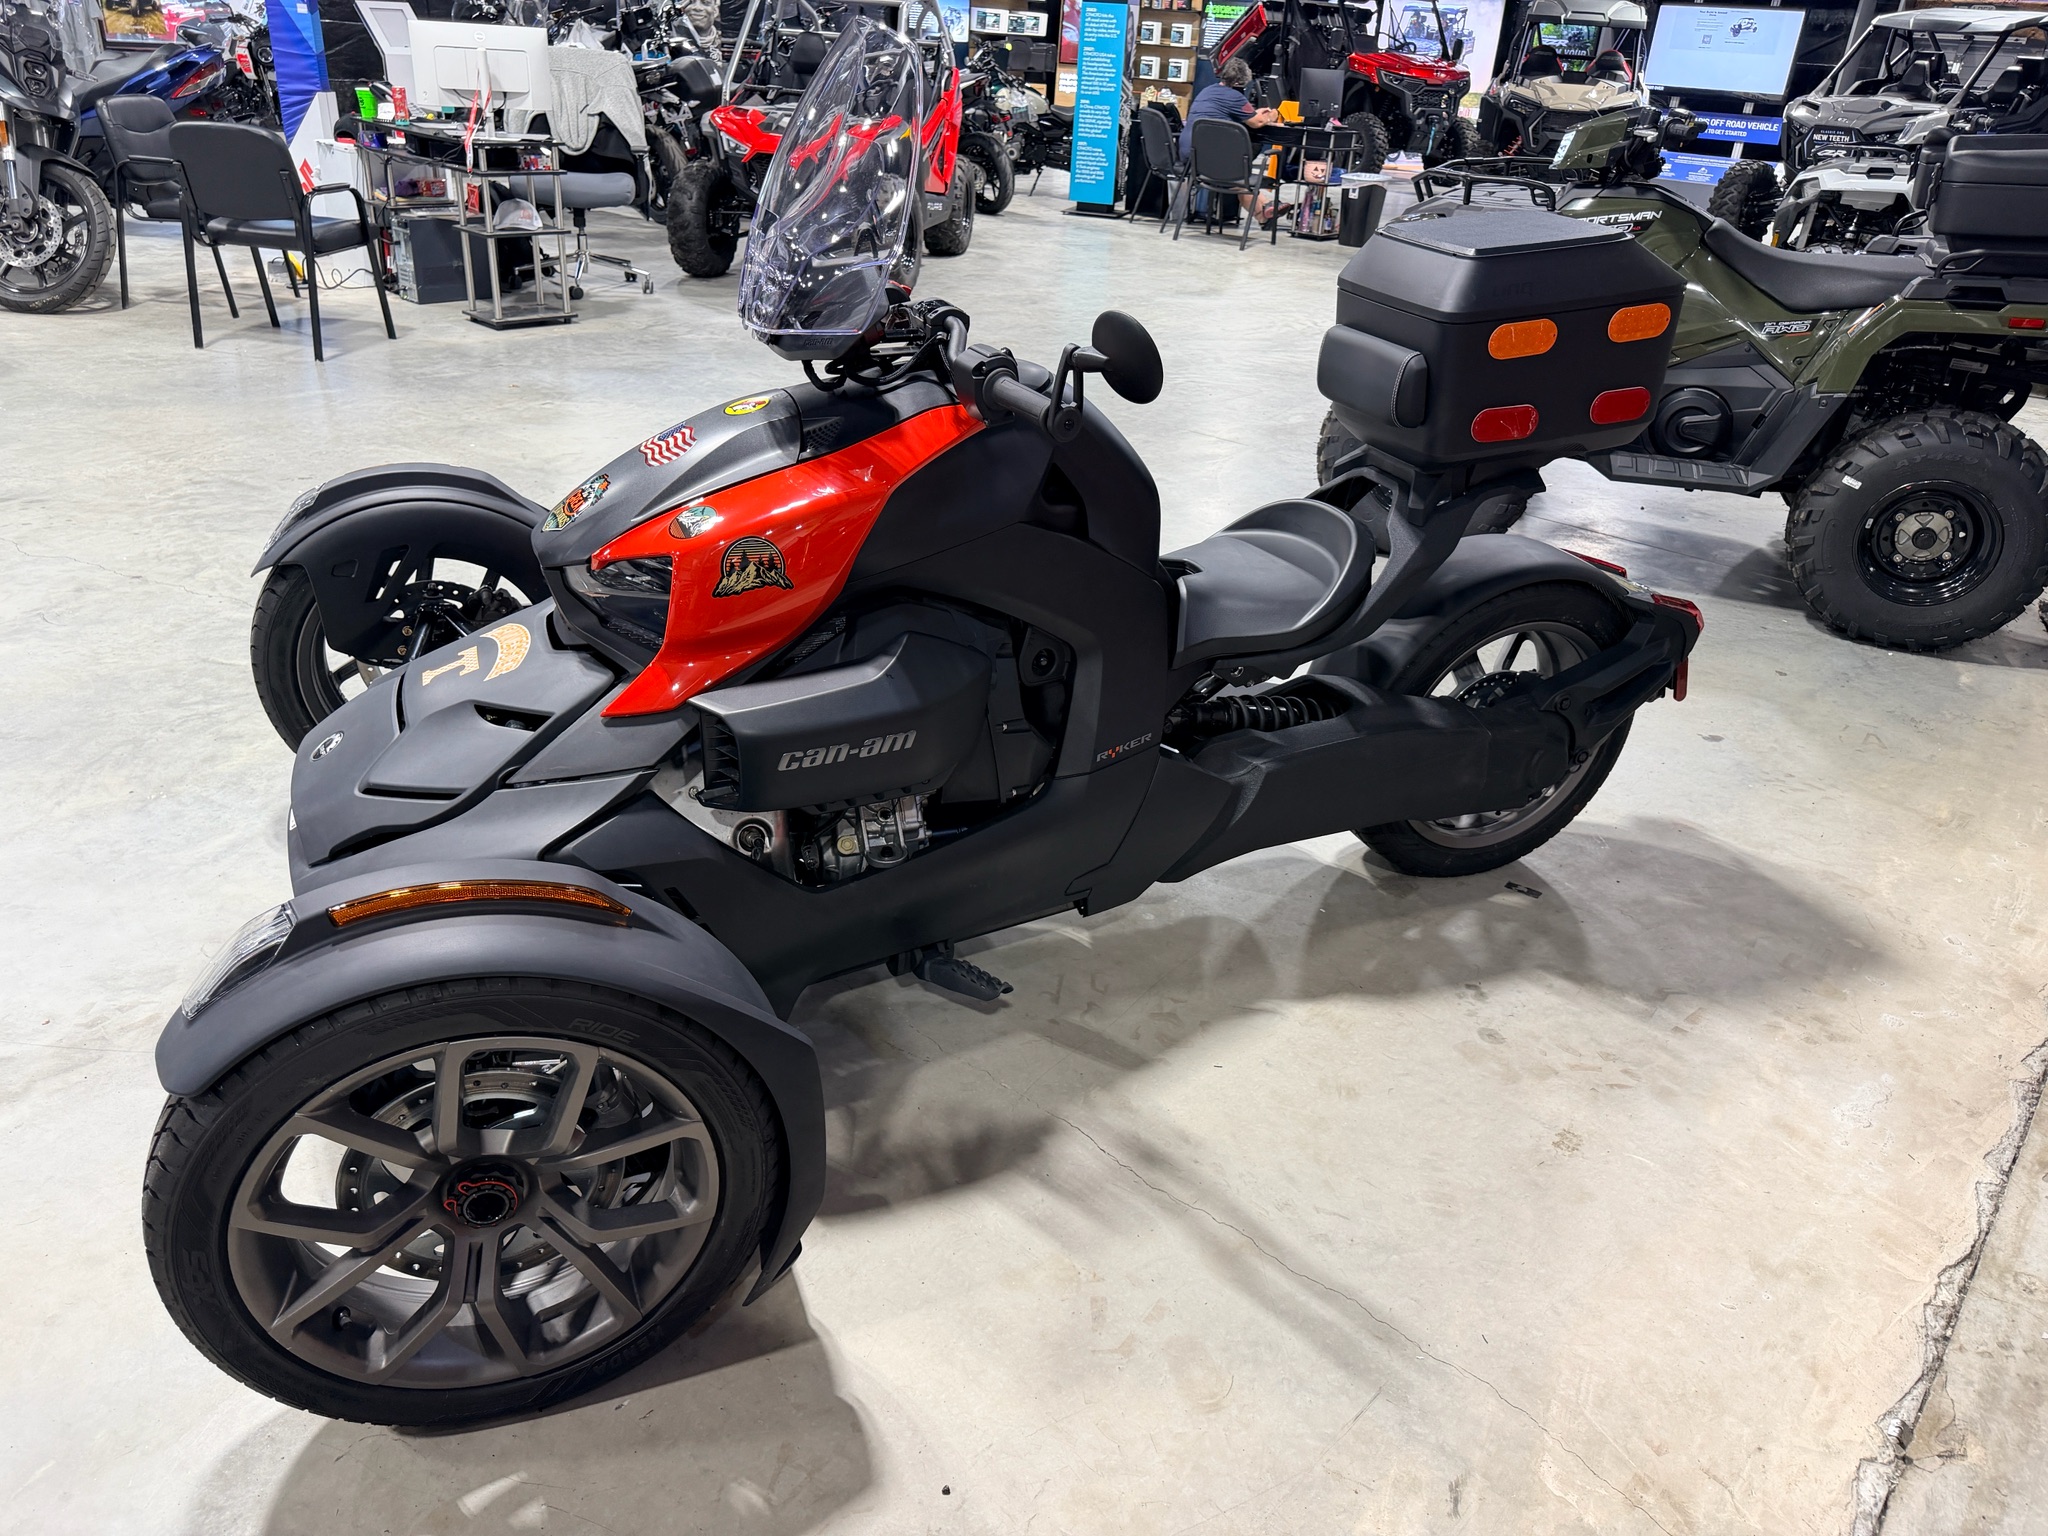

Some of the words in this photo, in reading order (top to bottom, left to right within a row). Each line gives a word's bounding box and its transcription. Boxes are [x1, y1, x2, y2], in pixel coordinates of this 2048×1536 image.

[1710, 119, 1725, 127] OFF
[1725, 120, 1746, 129] ROAD
[1747, 121, 1779, 132] VEHICLE
[1761, 323, 1810, 335] AWD
[777, 730, 917, 772] can-am
[1096, 732, 1152, 762] RYKER
[568, 1018, 640, 1044] RIDE
